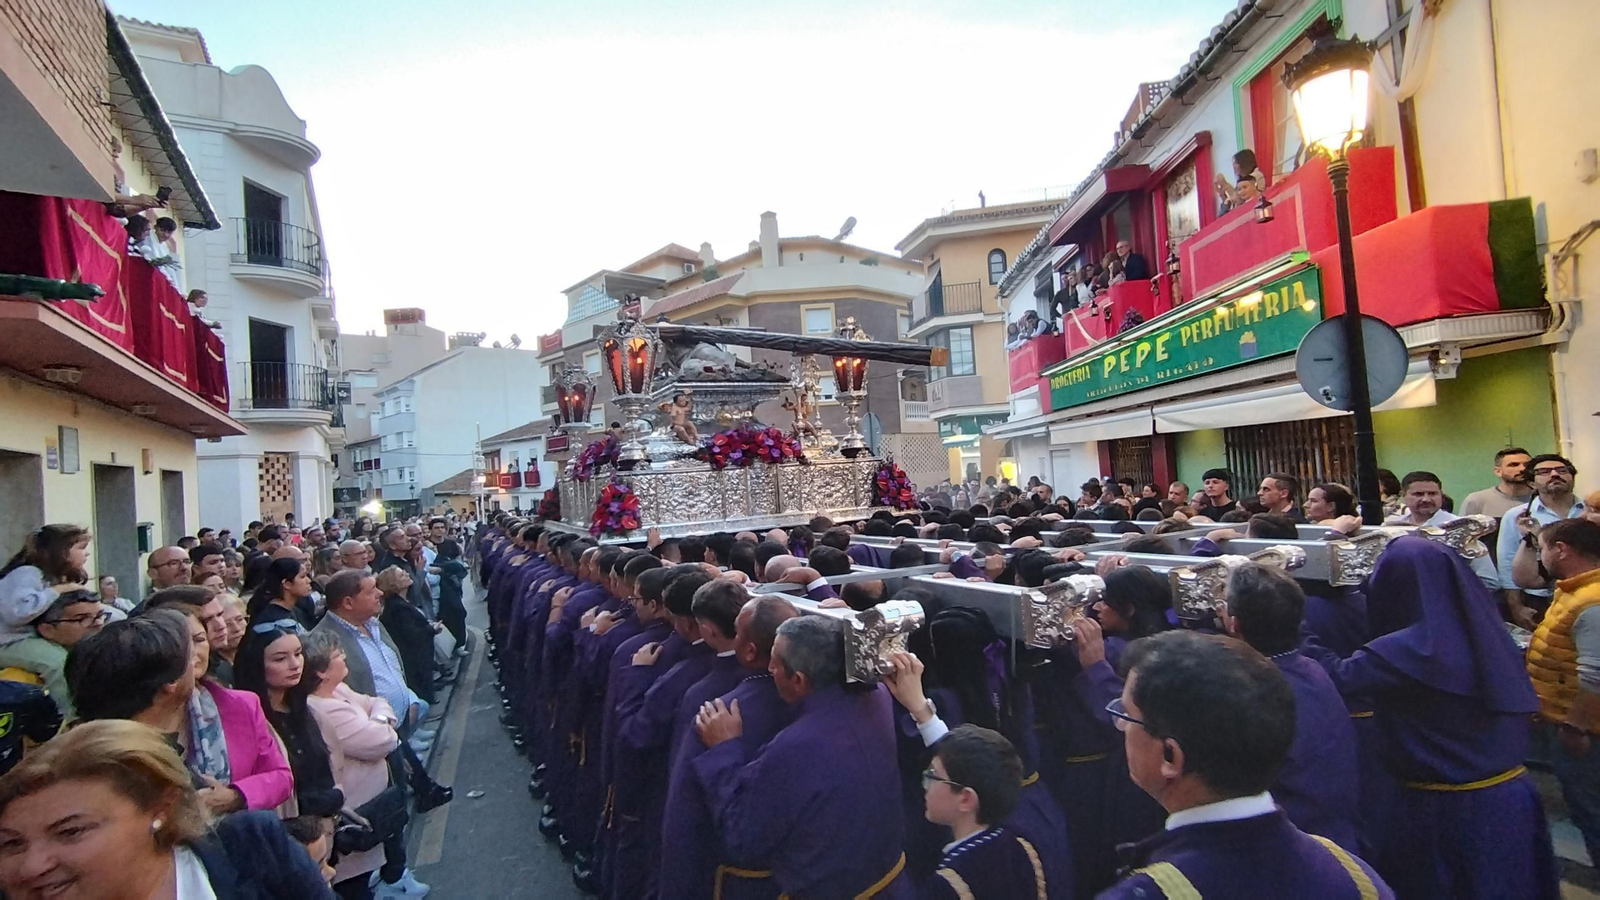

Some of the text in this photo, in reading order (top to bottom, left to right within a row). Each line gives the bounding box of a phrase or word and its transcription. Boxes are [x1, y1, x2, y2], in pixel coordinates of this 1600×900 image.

[1050, 280, 1306, 390] DROGUERIA PEPE PERFUMERIA
